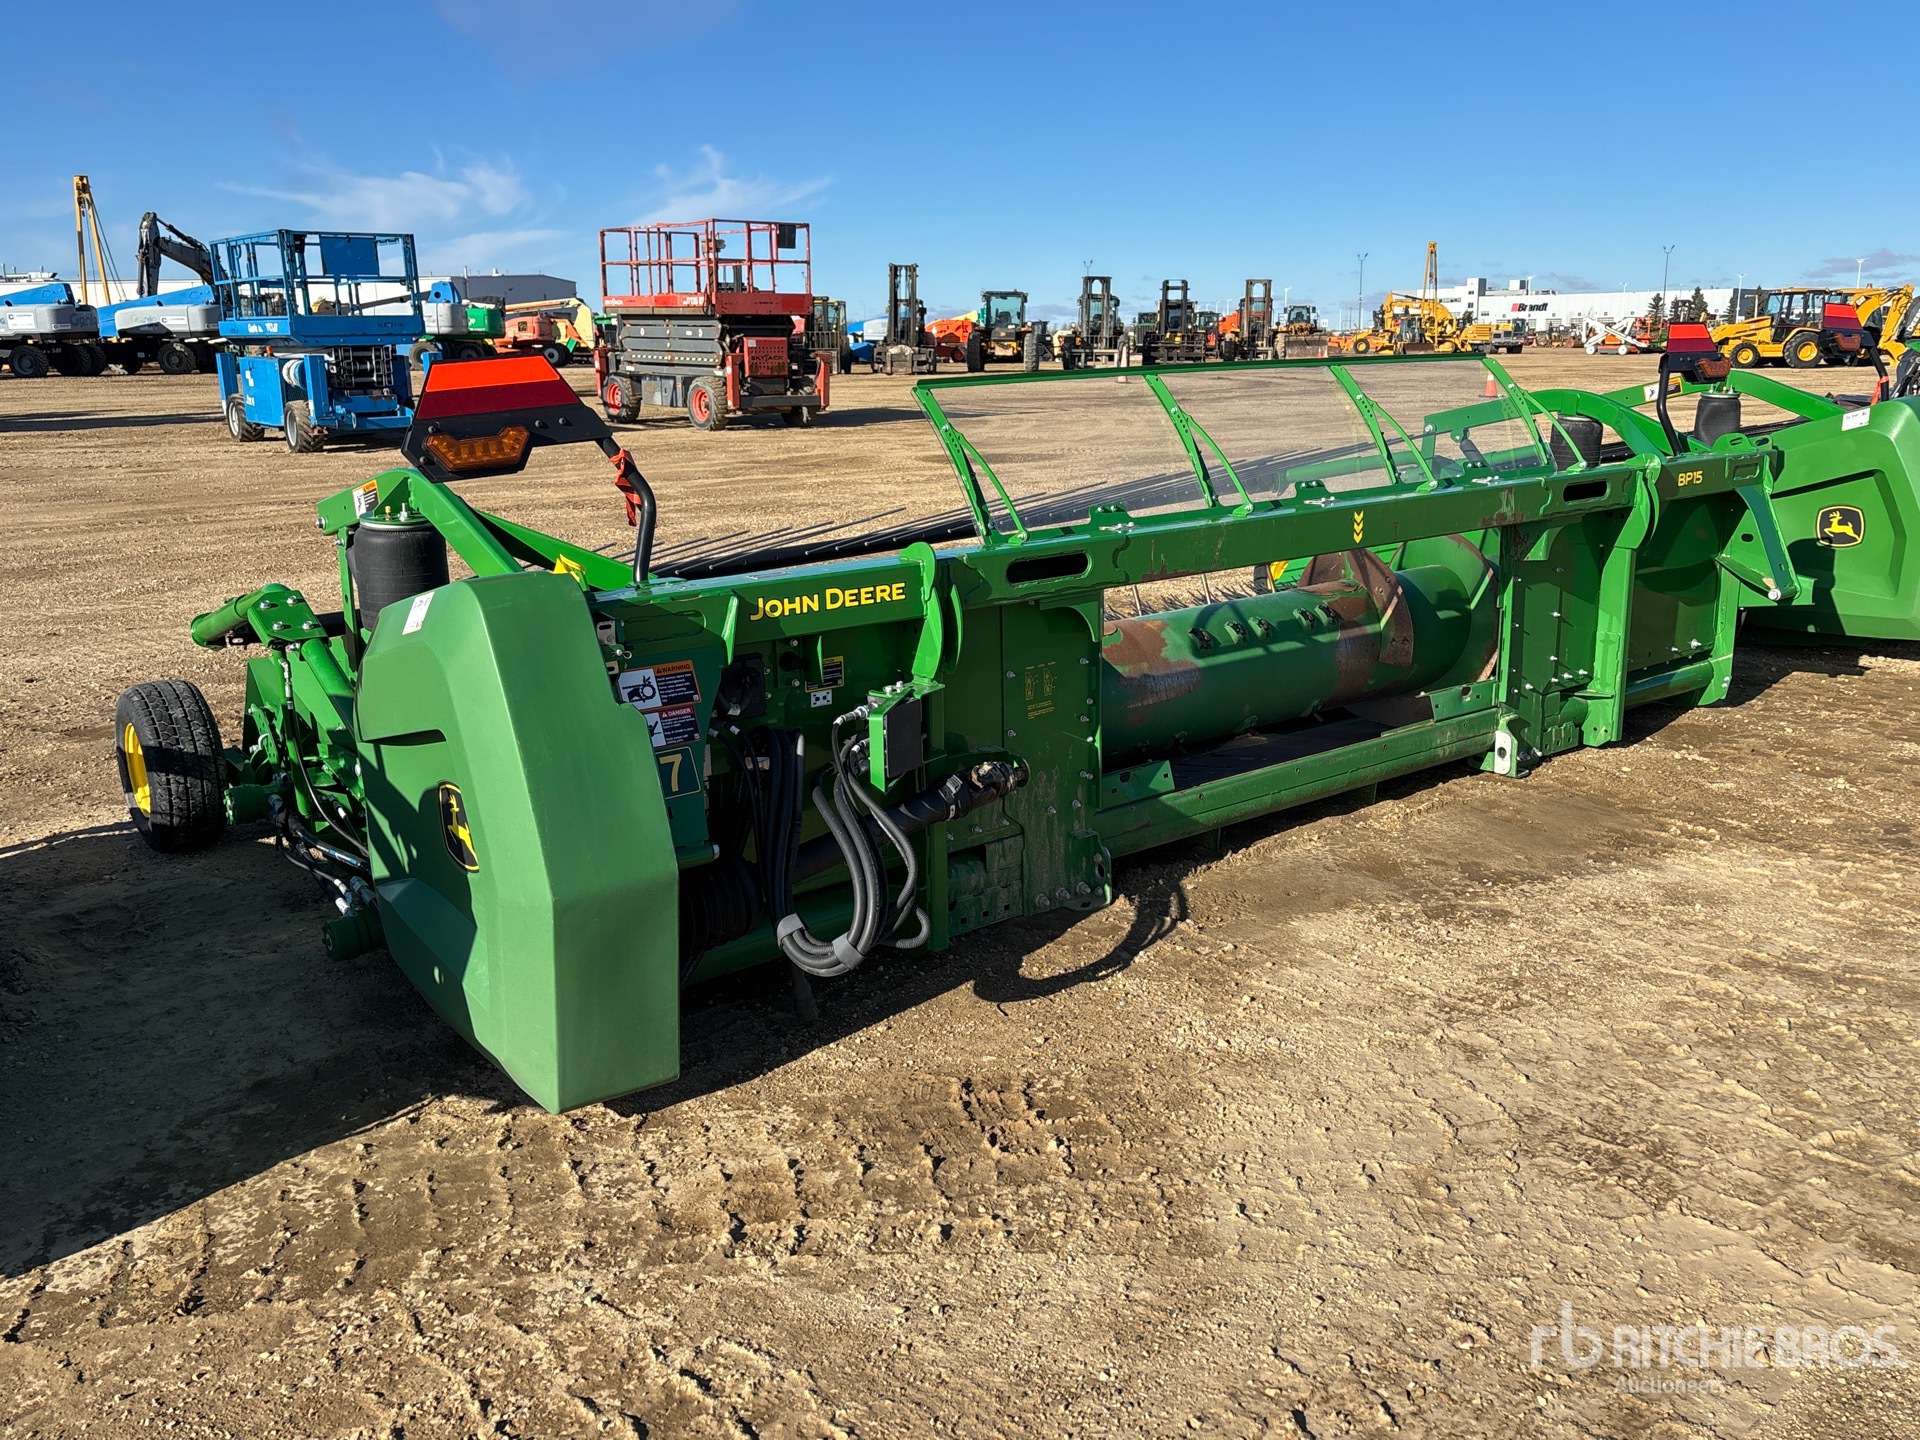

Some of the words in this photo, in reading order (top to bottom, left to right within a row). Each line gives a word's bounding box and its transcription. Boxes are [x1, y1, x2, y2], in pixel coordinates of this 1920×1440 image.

[1678, 471, 1703, 486] BP15
[750, 593, 819, 621] JOHN
[825, 582, 906, 610] DEERE
[661, 664, 690, 673] WARNING
[668, 708, 691, 717] DANGER
[659, 753, 683, 792] 7
